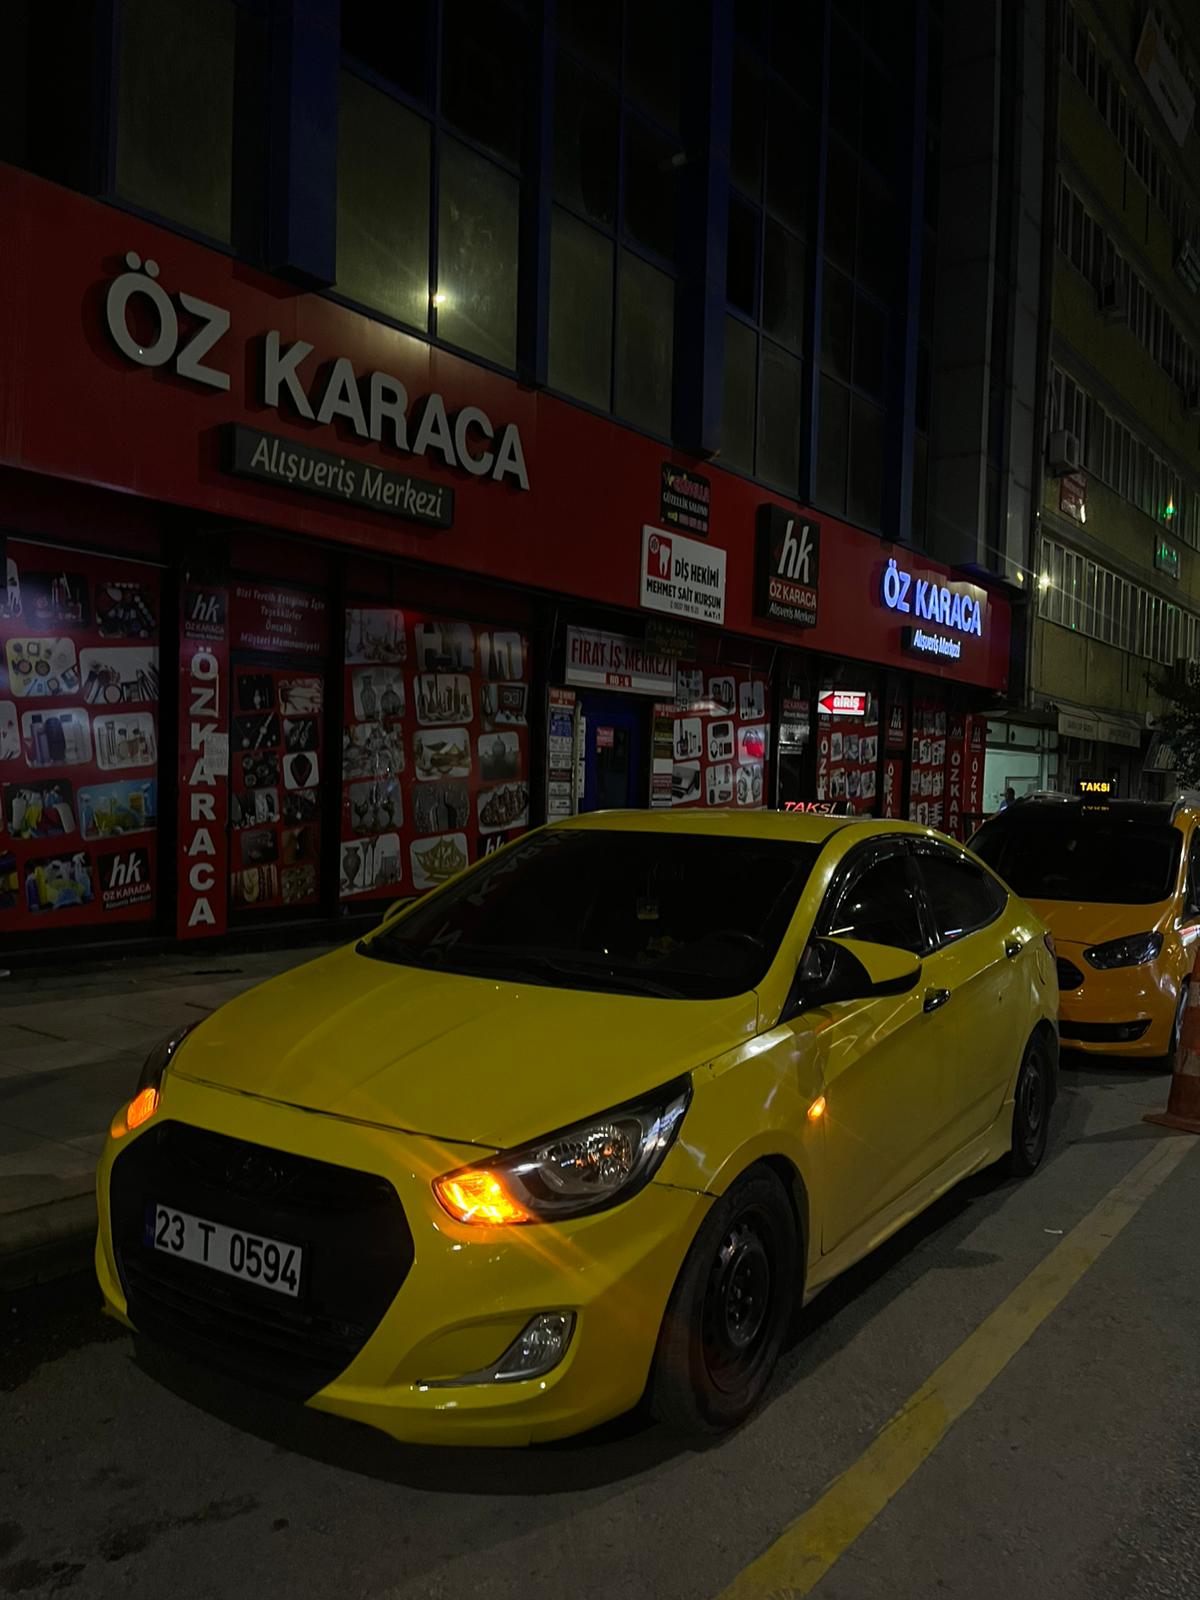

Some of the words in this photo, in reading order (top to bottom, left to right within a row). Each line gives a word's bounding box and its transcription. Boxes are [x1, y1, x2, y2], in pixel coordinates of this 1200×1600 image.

[106, 250, 231, 392] ÖZ
[264, 329, 530, 491] KARACA
[250, 436, 355, 499] Alışveriş
[360, 468, 443, 519] Merkezi
[674, 557, 689, 582] DİŞ
[690, 564, 719, 588] HEKİMİ
[777, 519, 813, 584] hk
[646, 578, 677, 599] MEHMET
[677, 586, 694, 602] SAİT
[694, 591, 721, 609] KURŞUN
[782, 585, 817, 609] KARACA
[883, 557, 911, 613] ÖZ
[915, 578, 982, 637] KARACA
[571, 638, 607, 667] FIRAT
[609, 640, 622, 672] İŞ
[109, 851, 142, 889] hk
[156, 1210, 185, 1251] 23
[198, 1222, 216, 1262] T
[230, 1233, 297, 1291] 0594
